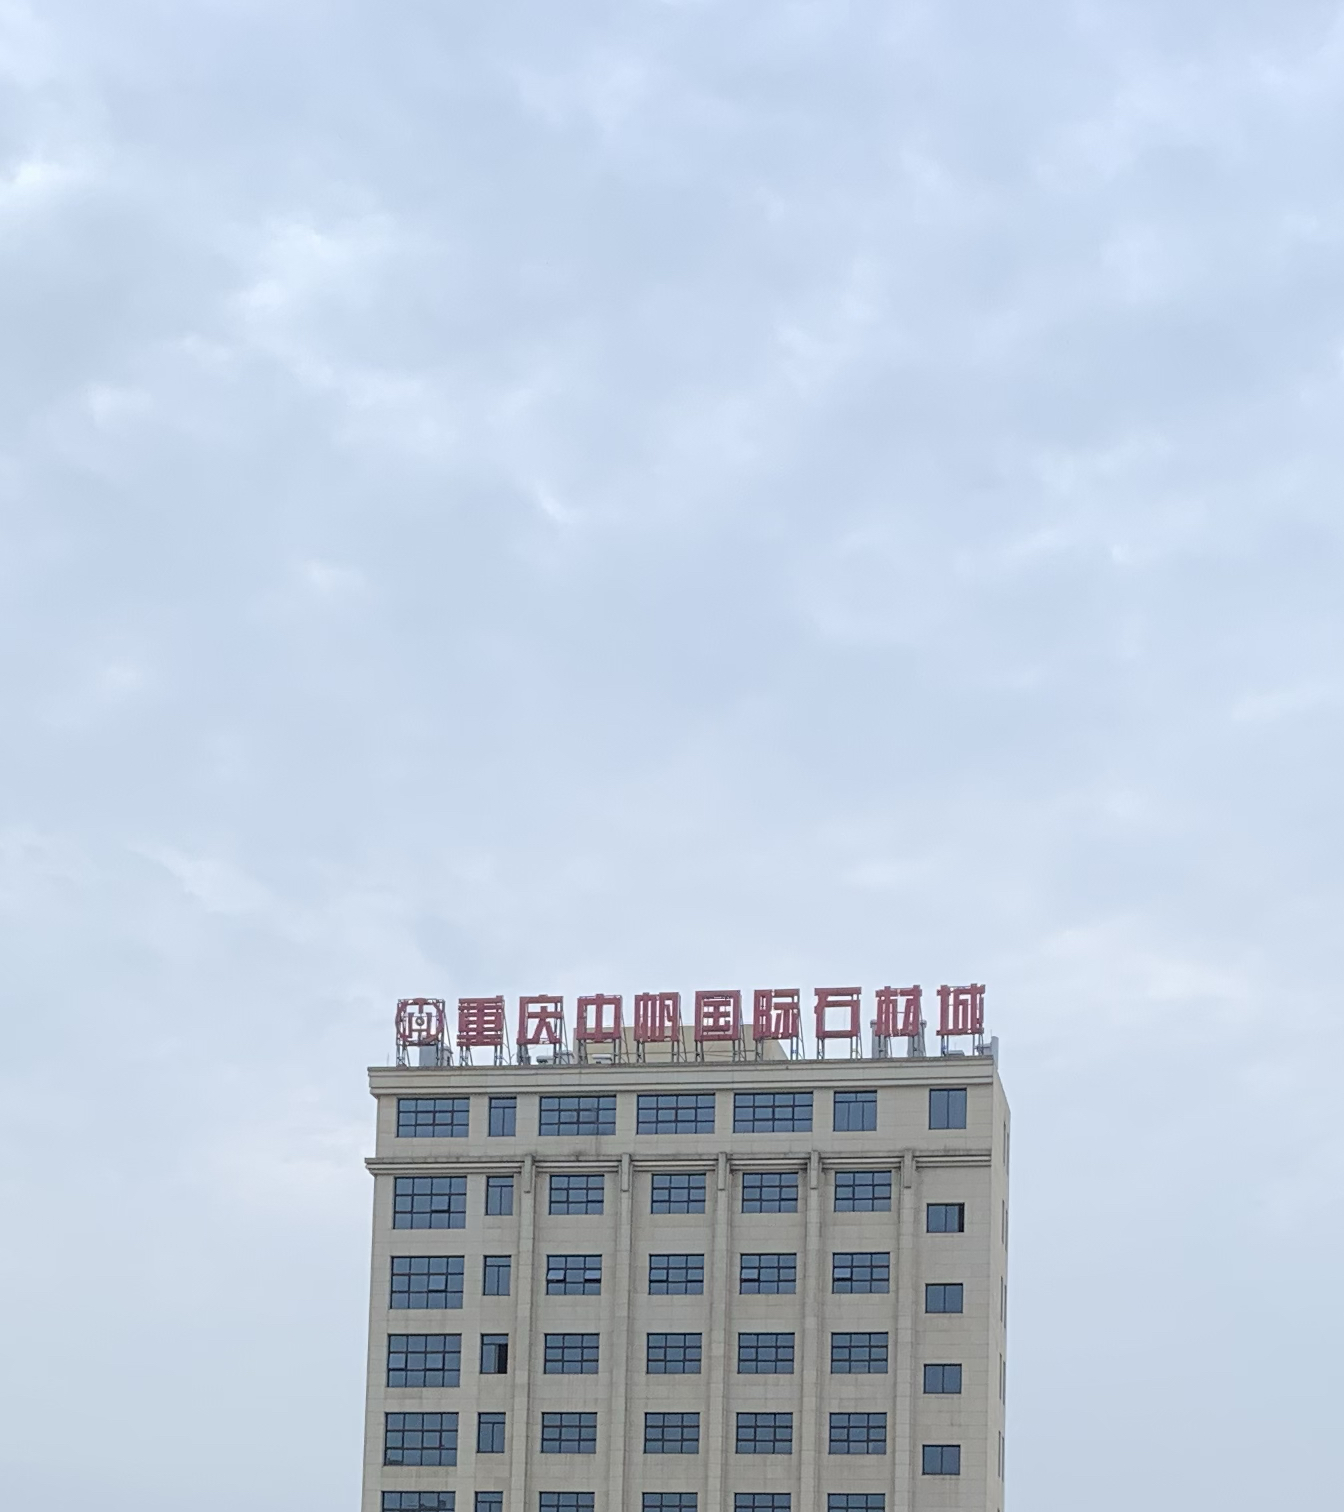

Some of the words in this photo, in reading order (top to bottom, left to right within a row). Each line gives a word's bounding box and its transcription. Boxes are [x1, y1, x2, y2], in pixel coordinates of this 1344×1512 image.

[457, 983, 986, 1047] 重庆中帆国际石材城
